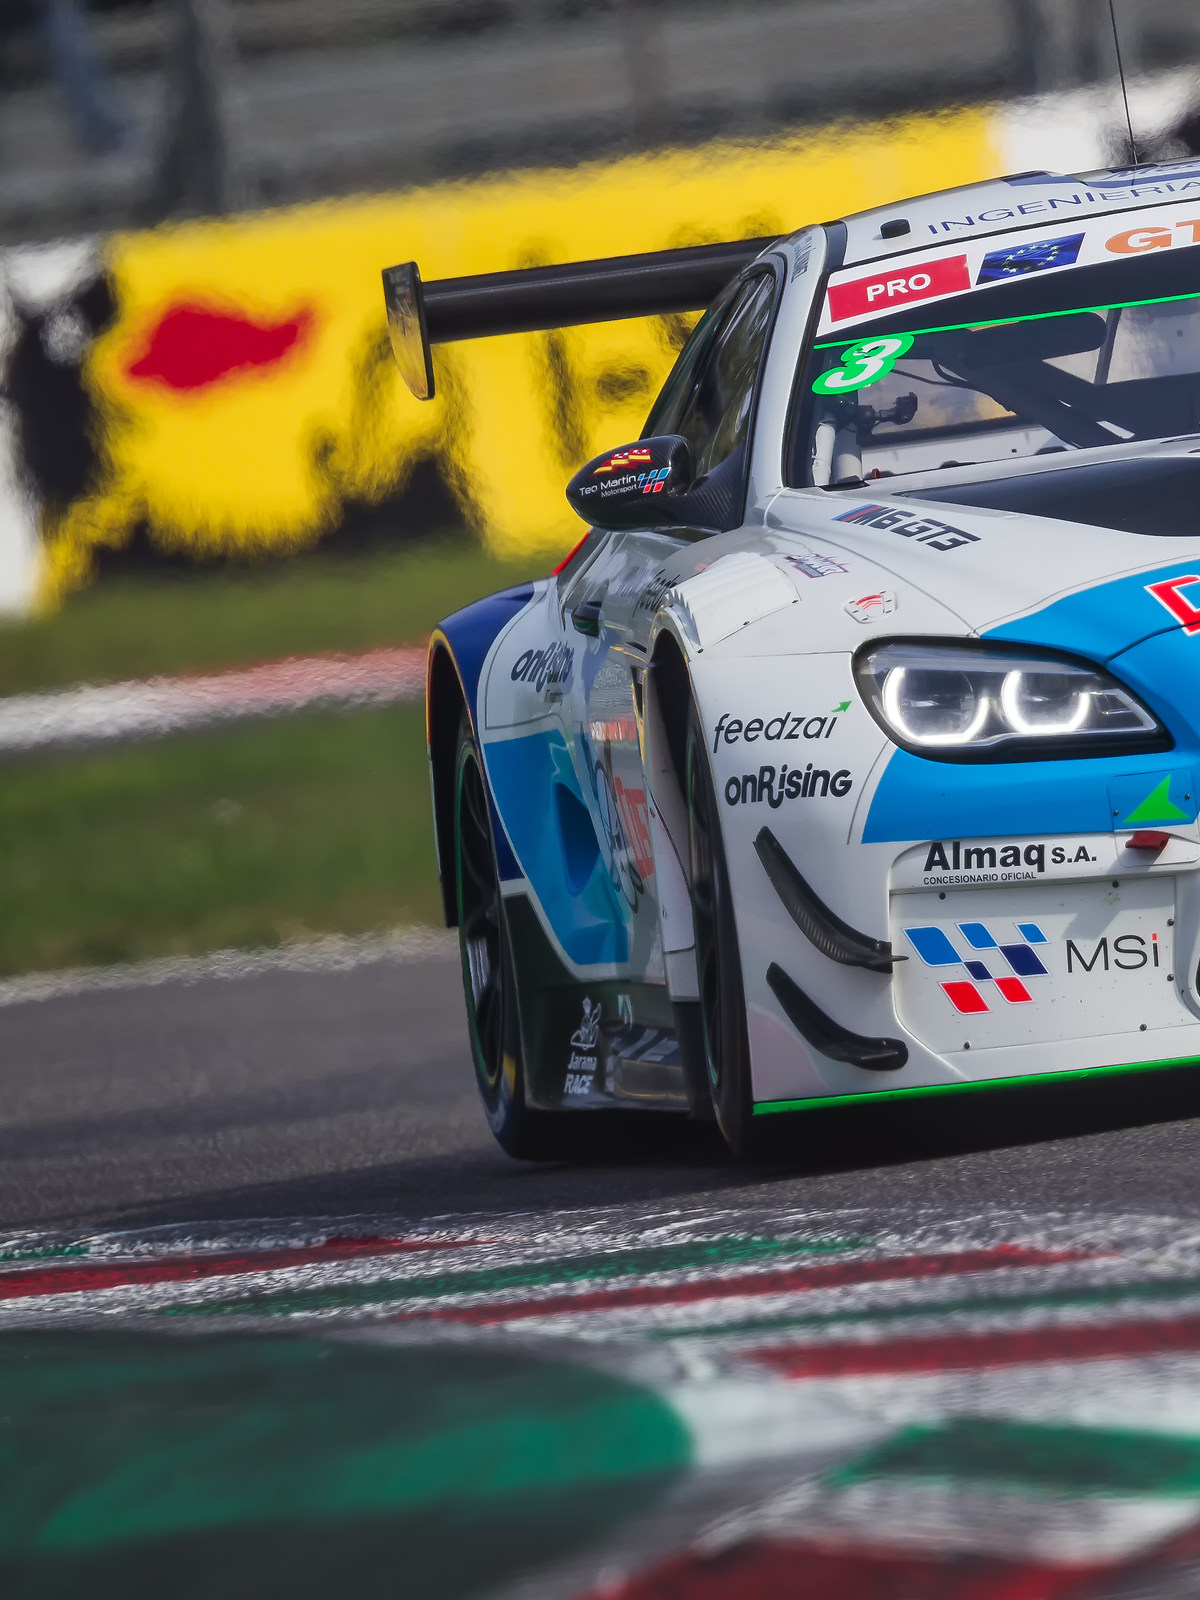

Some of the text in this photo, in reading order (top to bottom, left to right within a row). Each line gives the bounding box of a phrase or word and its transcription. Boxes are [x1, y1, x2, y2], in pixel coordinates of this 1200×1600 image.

[866, 273, 931, 302] PRO
[824, 338, 903, 388] 3
[579, 484, 598, 496] Teo
[601, 484, 637, 498] Motorsport
[713, 709, 838, 753] feedzai
[724, 763, 852, 809] onRising
[923, 841, 1097, 873] Almaq S.A.
[923, 871, 1037, 886] CONCESIONARIO OFICIAL
[1066, 933, 1160, 974] MSi
[564, 1073, 595, 1095] RACE
